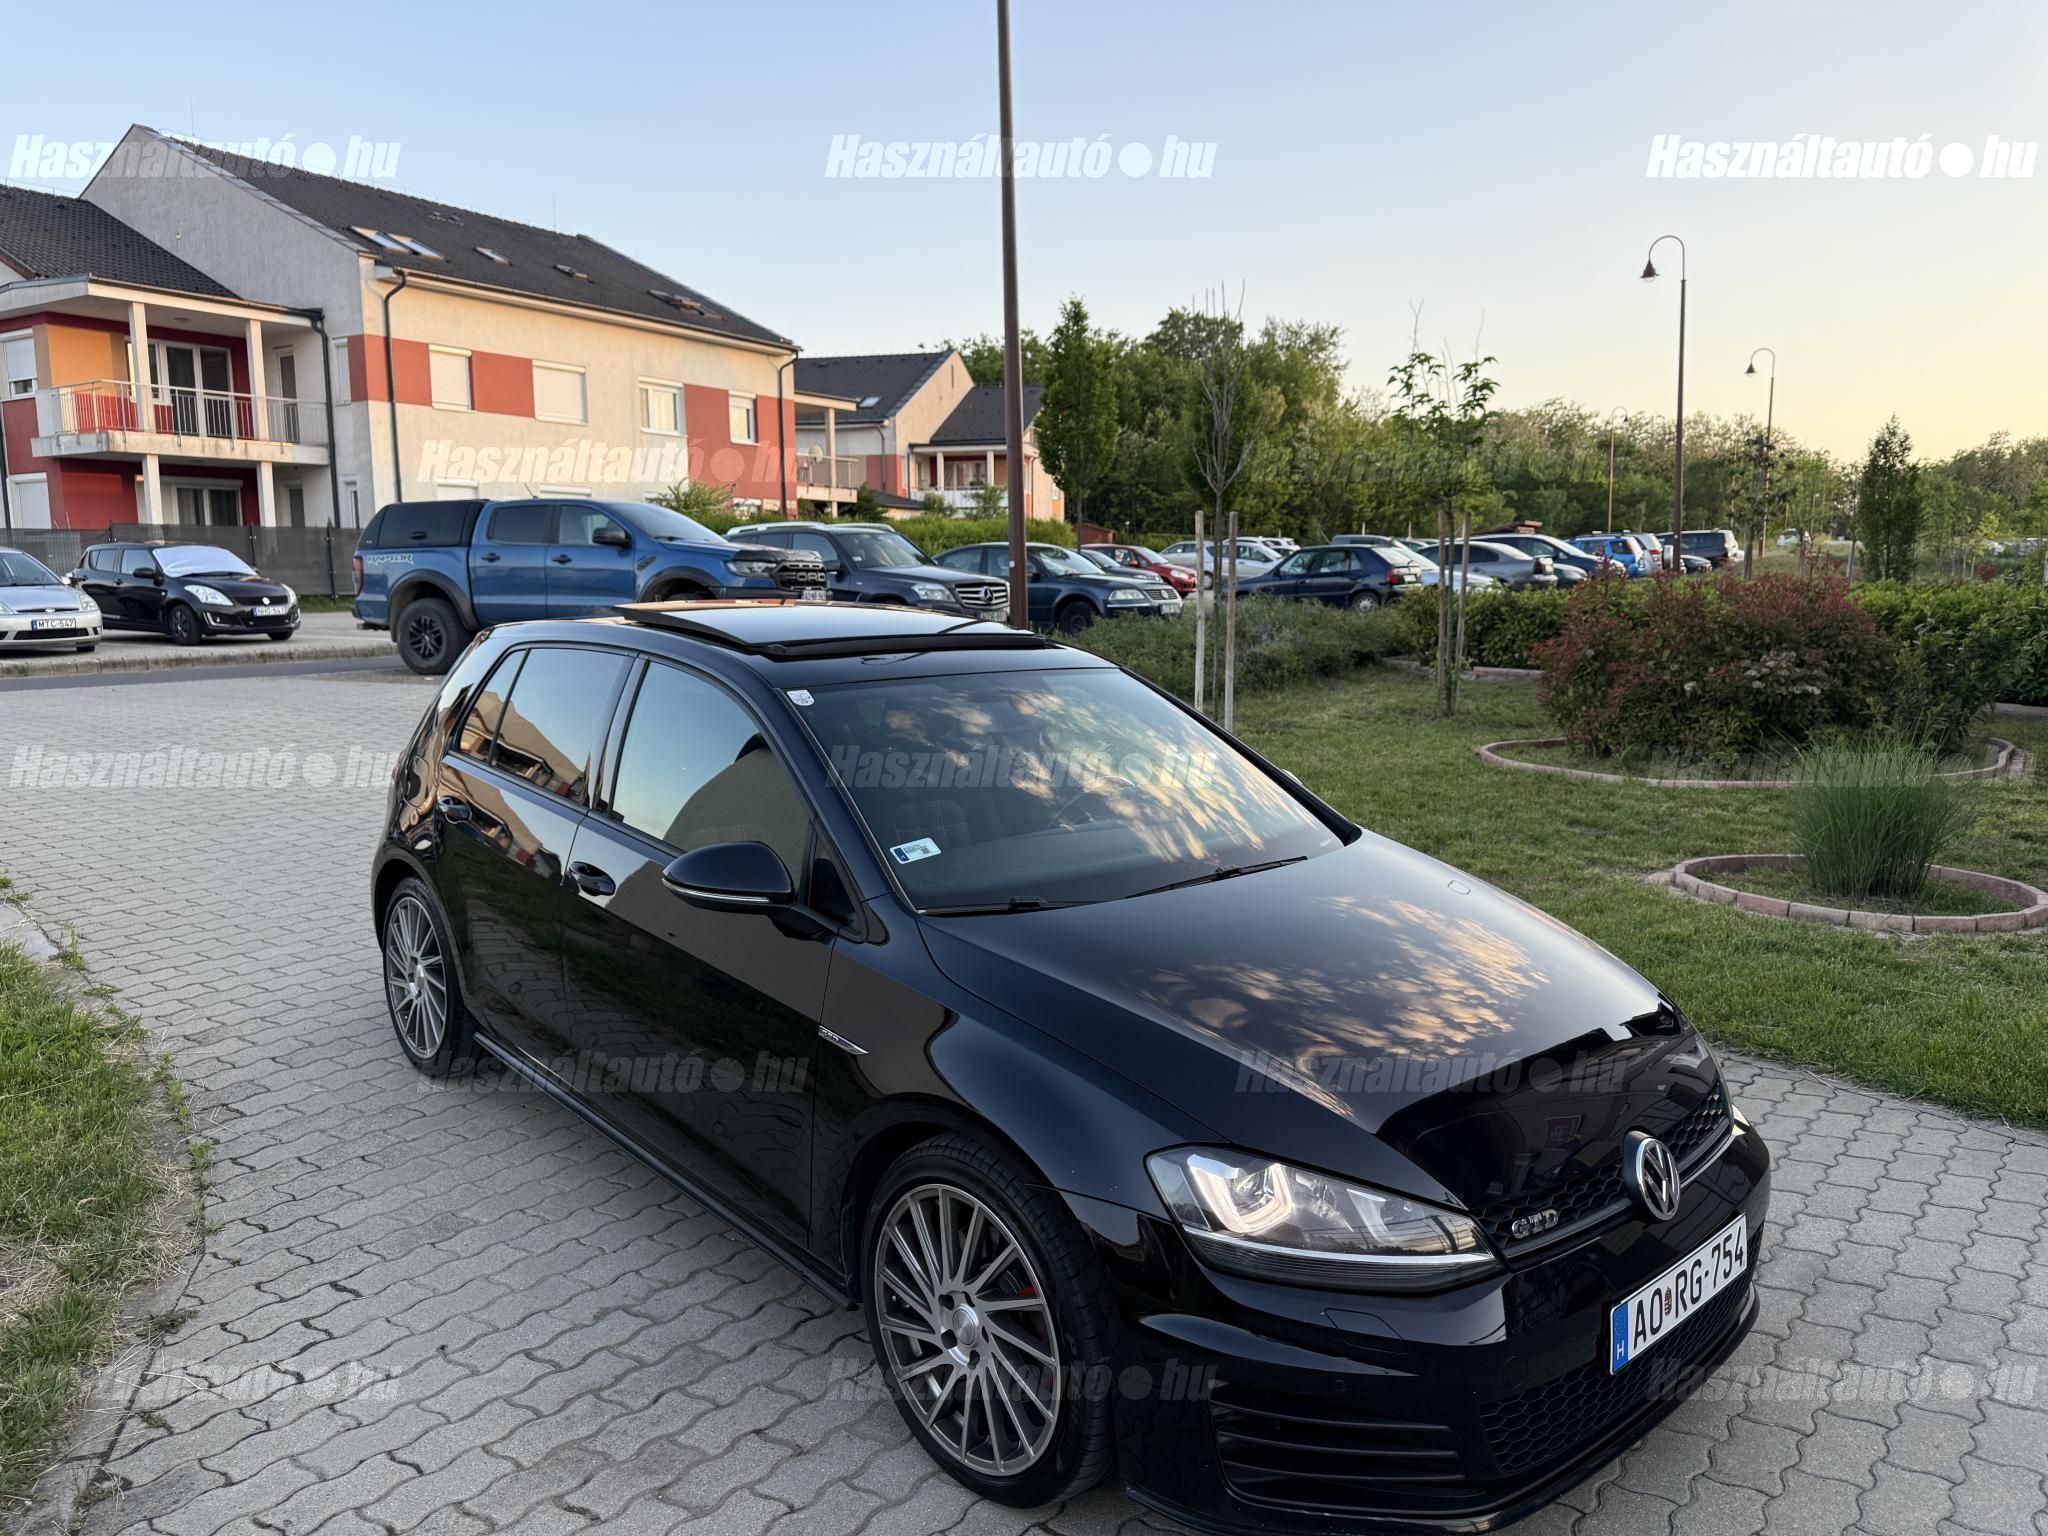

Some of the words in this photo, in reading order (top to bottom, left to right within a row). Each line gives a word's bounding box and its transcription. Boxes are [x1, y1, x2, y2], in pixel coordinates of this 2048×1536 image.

[777, 572, 825, 582] FORD
[1511, 1208, 1559, 1239] GTD
[1674, 1225, 1744, 1318] RG-754
